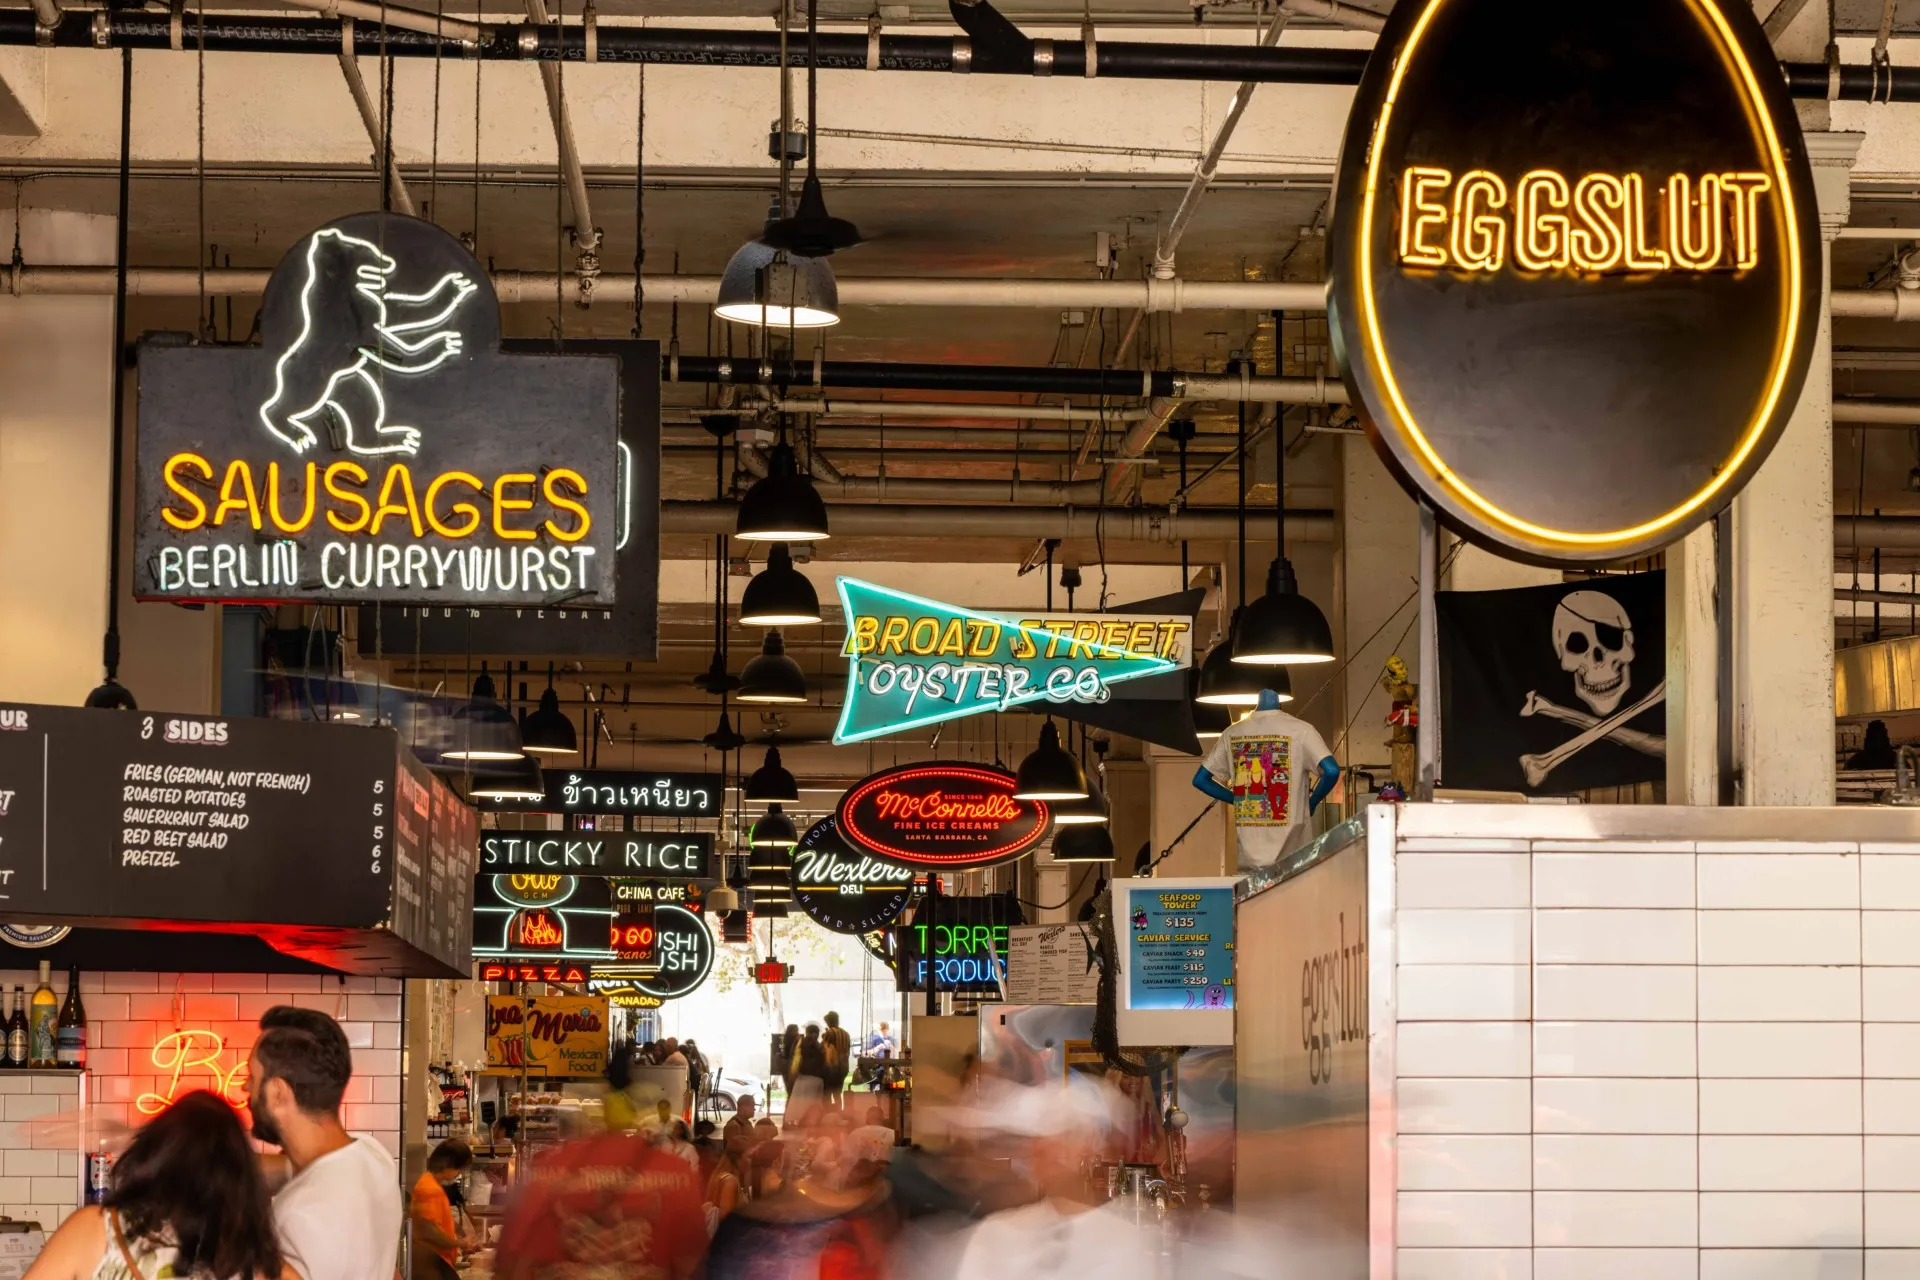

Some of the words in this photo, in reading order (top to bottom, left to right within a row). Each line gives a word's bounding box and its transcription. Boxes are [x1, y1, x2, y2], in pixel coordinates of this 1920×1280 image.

[1399, 165, 1771, 272] EGGSLUT
[161, 451, 591, 542] SAUSAGES
[159, 540, 298, 591] BERLIN
[321, 542, 596, 592] CURRYWURST
[847, 615, 1003, 658] BROAD
[1015, 619, 1190, 661] STREET
[868, 661, 1036, 715] OYSTER
[0, 710, 28, 729] UR
[141, 716, 155, 739] 3
[166, 720, 229, 744] SIDES
[124, 763, 162, 782] FRIES
[164, 765, 226, 789] (GERMAN,
[227, 771, 256, 788] NOT
[256, 772, 311, 794] FRENCH)
[373, 780, 384, 794] 5
[123, 785, 182, 804] ROASTED
[184, 789, 246, 809] POTATOES
[563, 774, 709, 809] ข้าวเหนียว
[373, 803, 383, 816] 5
[876, 790, 1021, 819] McConnell's
[123, 807, 208, 826] SAUERKRAUT
[208, 812, 249, 830] SALAD
[894, 822, 920, 830] FINE
[926, 822, 945, 830] ICE
[951, 822, 999, 830] CREAMS
[122, 828, 151, 845] RED
[154, 829, 188, 847] BEET
[186, 832, 228, 849] SALAD
[373, 826, 384, 839] 5
[805, 819, 835, 846] HOUS
[122, 849, 180, 867] PRETZEL
[372, 845, 382, 858] 6
[485, 838, 603, 866] STICKY
[625, 841, 699, 870] RICE
[371, 860, 381, 874] 6
[617, 886, 652, 900] CHINA
[657, 887, 685, 900] CAFE
[840, 884, 863, 895] DELI
[1159, 894, 1201, 902] SEAFOOD
[802, 895, 843, 928] HAND
[862, 895, 902, 928] SLICED
[1165, 917, 1195, 928] $135
[2, 925, 28, 941] PREMIUM
[626, 927, 653, 945] GO
[914, 925, 1009, 955] TORRE
[1137, 934, 1171, 942] CAVIAR
[1174, 933, 1210, 942] SERVICE
[617, 951, 651, 960] canos
[1186, 949, 1205, 957] $40
[486, 967, 584, 981] PIZZA
[918, 959, 1007, 983] PRODUC
[1183, 963, 1205, 971] $115
[1183, 977, 1208, 985] $250
[611, 996, 661, 1007] PANADAS
[1302, 904, 1366, 1086] eggslut
[527, 1009, 602, 1045] Maria
[559, 1047, 603, 1059] Mexican
[136, 1030, 248, 1114] Be
[568, 1061, 596, 1072] Food
